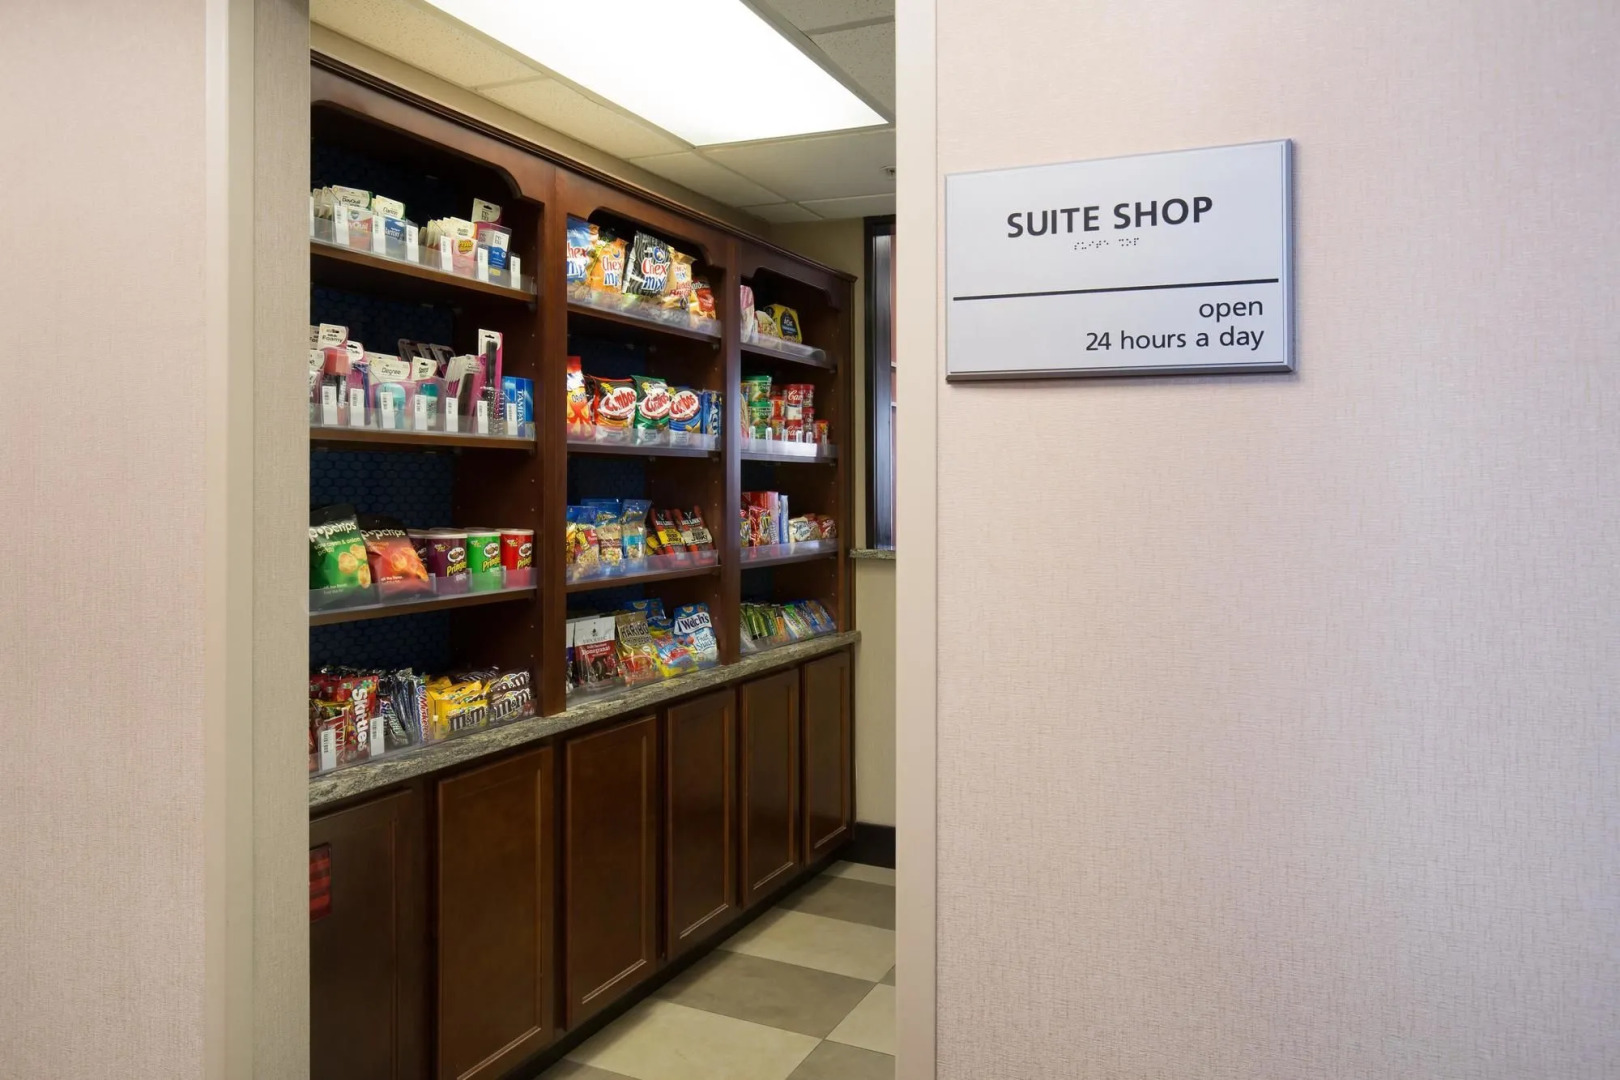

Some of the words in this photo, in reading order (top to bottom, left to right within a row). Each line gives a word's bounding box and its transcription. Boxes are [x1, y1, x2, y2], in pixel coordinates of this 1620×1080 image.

[1007, 205, 1100, 238] SUITE
[1113, 196, 1213, 230] SHOP
[567, 242, 589, 259] hex
[642, 259, 668, 276] Chex
[1199, 300, 1263, 323] open
[1086, 331, 1112, 351] 24
[1120, 330, 1187, 350] hours
[1195, 332, 1209, 347] a
[1219, 326, 1265, 350] day
[381, 367, 402, 376] Degree
[517, 389, 526, 427] TAMPAX
[604, 389, 636, 411] Combos
[308, 521, 357, 542] popchips
[360, 528, 406, 540] popchips
[621, 622, 649, 638] HARIBO
[681, 613, 710, 630] Welch's
[352, 688, 369, 752] Skittles
